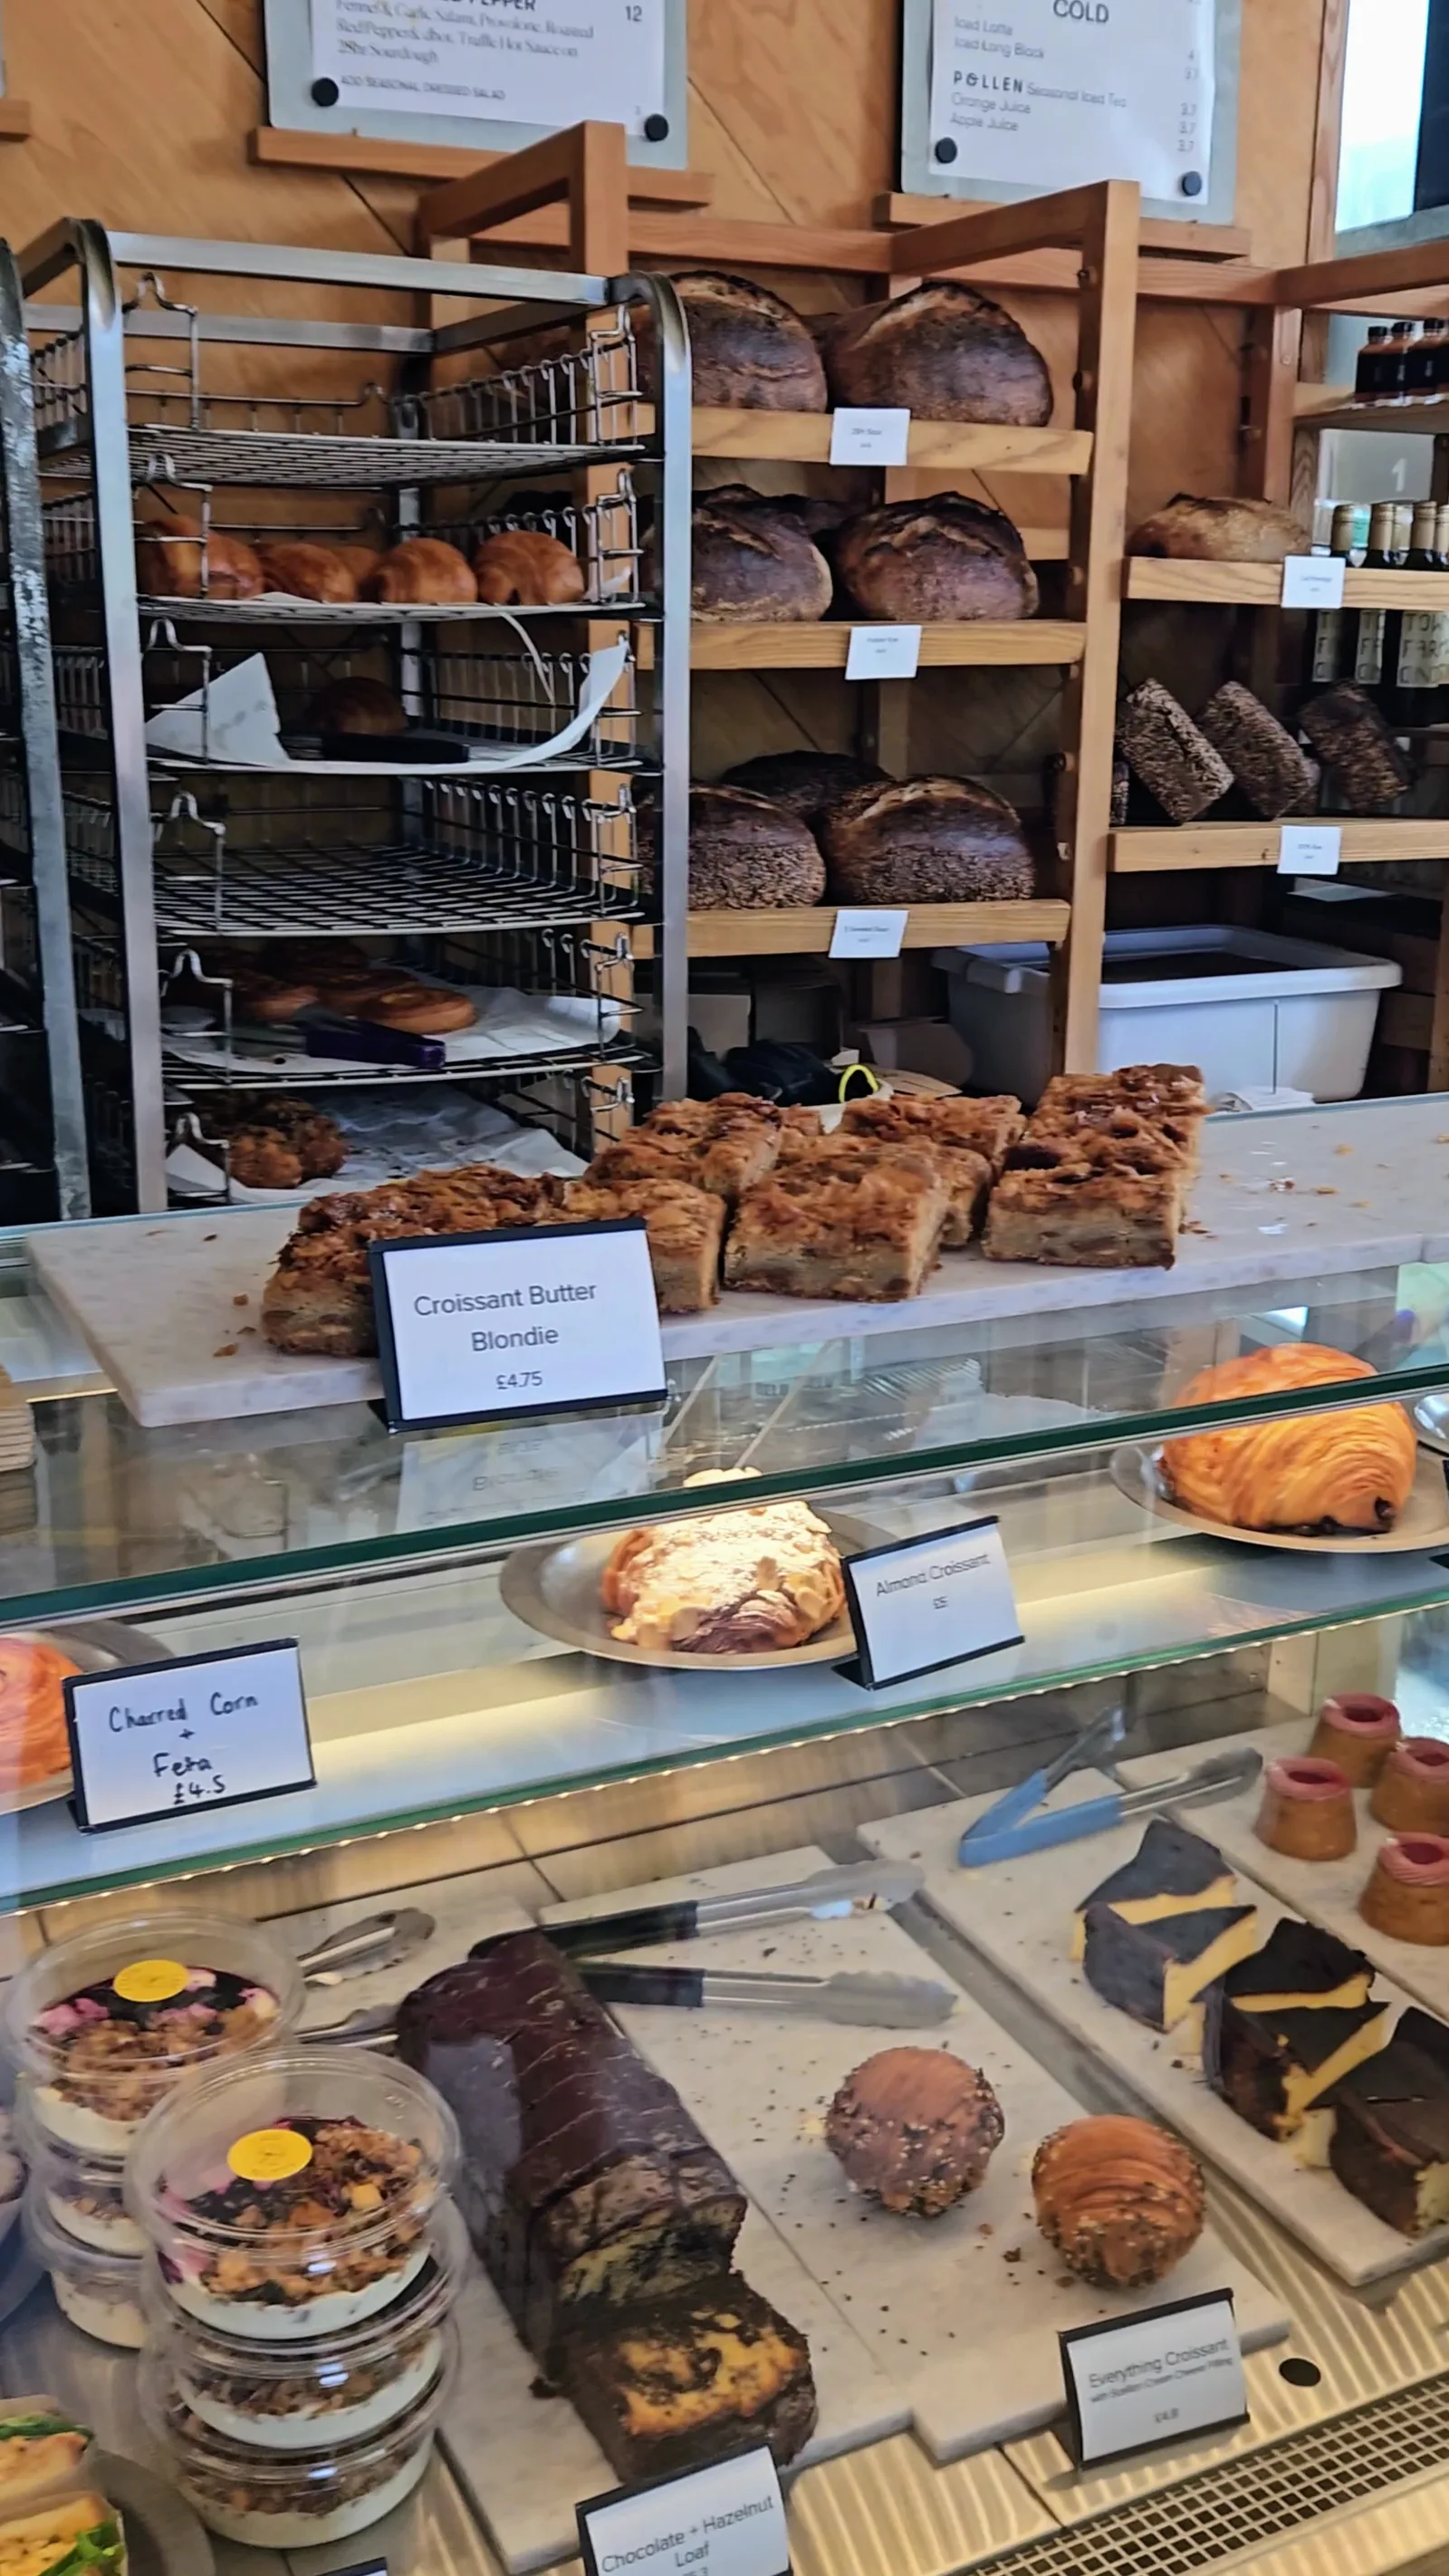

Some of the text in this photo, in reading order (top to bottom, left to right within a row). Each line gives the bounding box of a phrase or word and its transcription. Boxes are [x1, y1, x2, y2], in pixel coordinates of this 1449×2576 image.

[626, 5, 642, 22] 12
[1052, 0, 1110, 24] COLD
[955, 36, 980, 50] Iced
[1013, 42, 1045, 59] Black
[952, 91, 1032, 114] Orange Juice
[987, 117, 1019, 131] Juice
[414, 1283, 597, 1316] Croissant Butter
[471, 1326, 559, 1352] Blondie
[496, 1370, 542, 1389] £4.75
[876, 1553, 992, 1597] Almond Croissant
[109, 1691, 259, 1732] Charred Corn
[178, 1727, 196, 1739] +
[153, 1752, 213, 1778] Feta
[173, 1774, 226, 1805] £4.5
[1089, 2339, 1229, 2389] Everything Croissant
[601, 2495, 774, 2573] Chocolate + Hazelnut
[674, 2541, 709, 2568] Loaf
